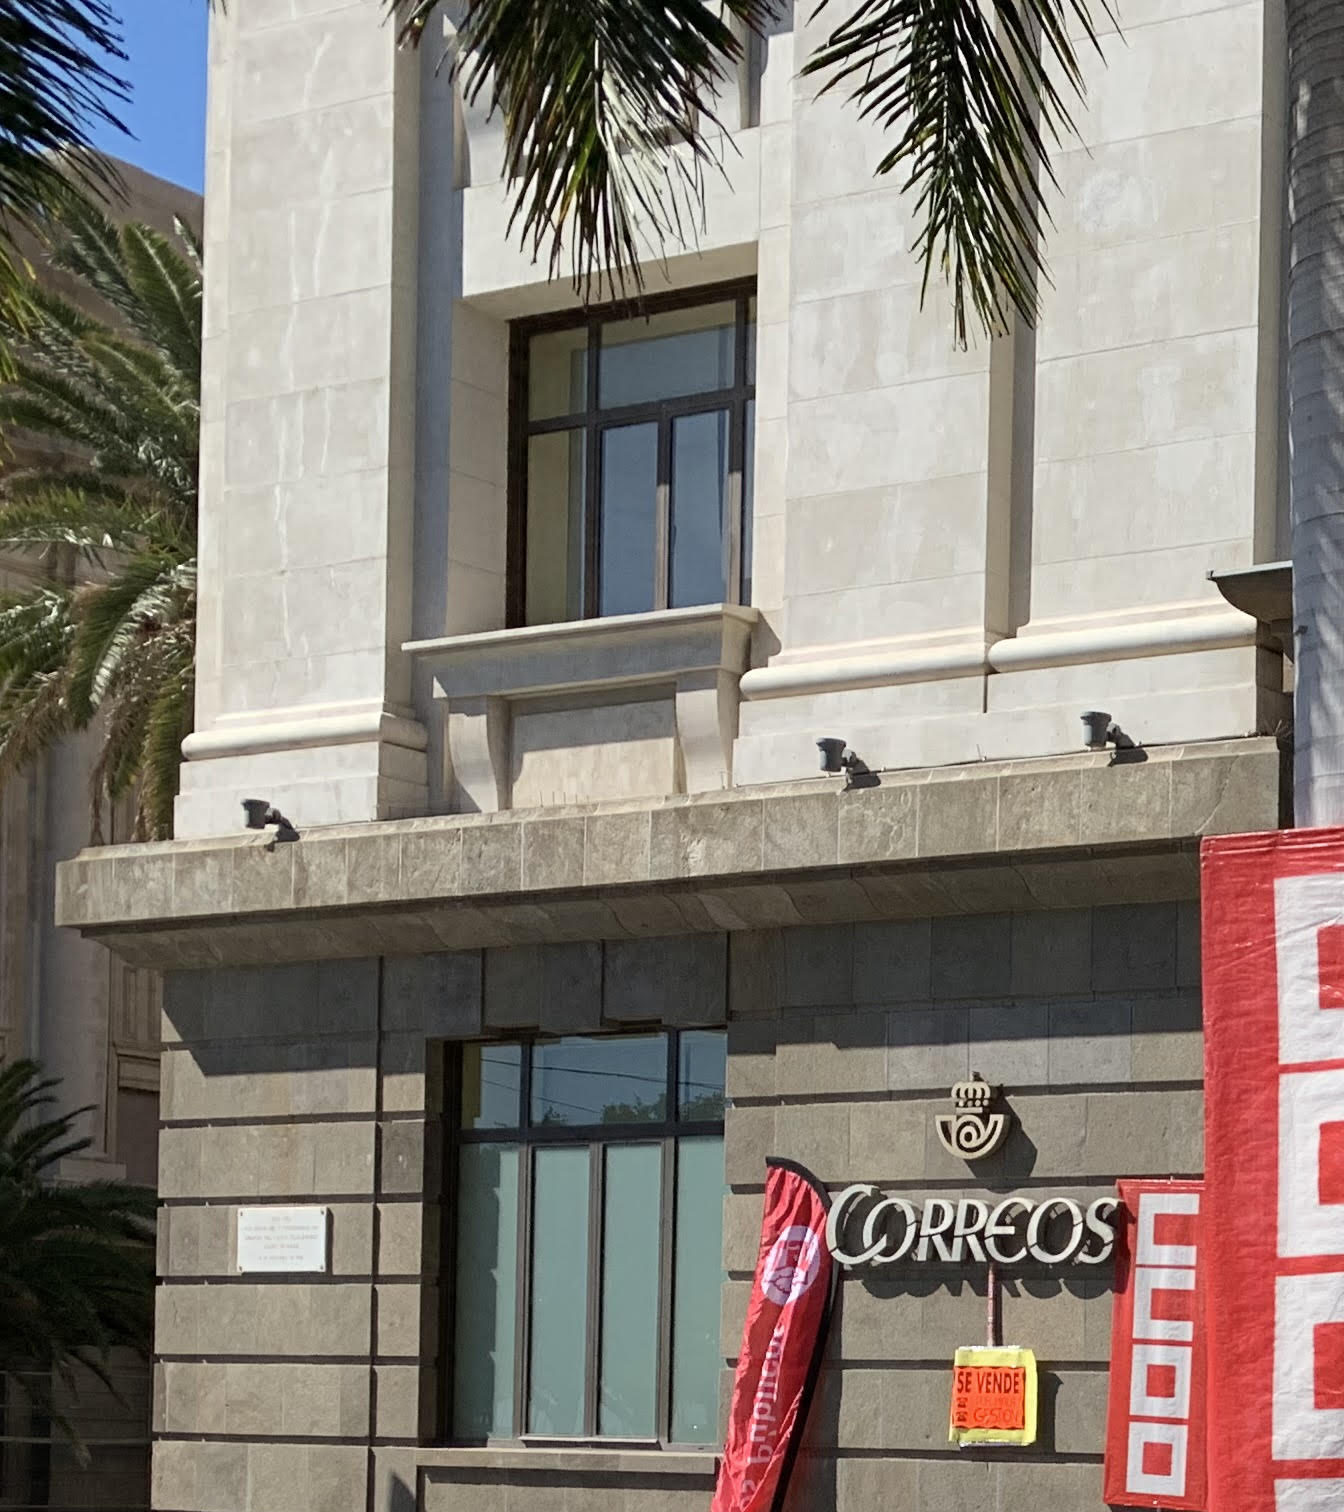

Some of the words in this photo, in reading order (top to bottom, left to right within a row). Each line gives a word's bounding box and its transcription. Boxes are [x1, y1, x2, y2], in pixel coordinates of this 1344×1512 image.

[957, 1372, 972, 1393] SE
[977, 1372, 1019, 1394] VENDE
[1126, 1193, 1200, 1496] CCOO
